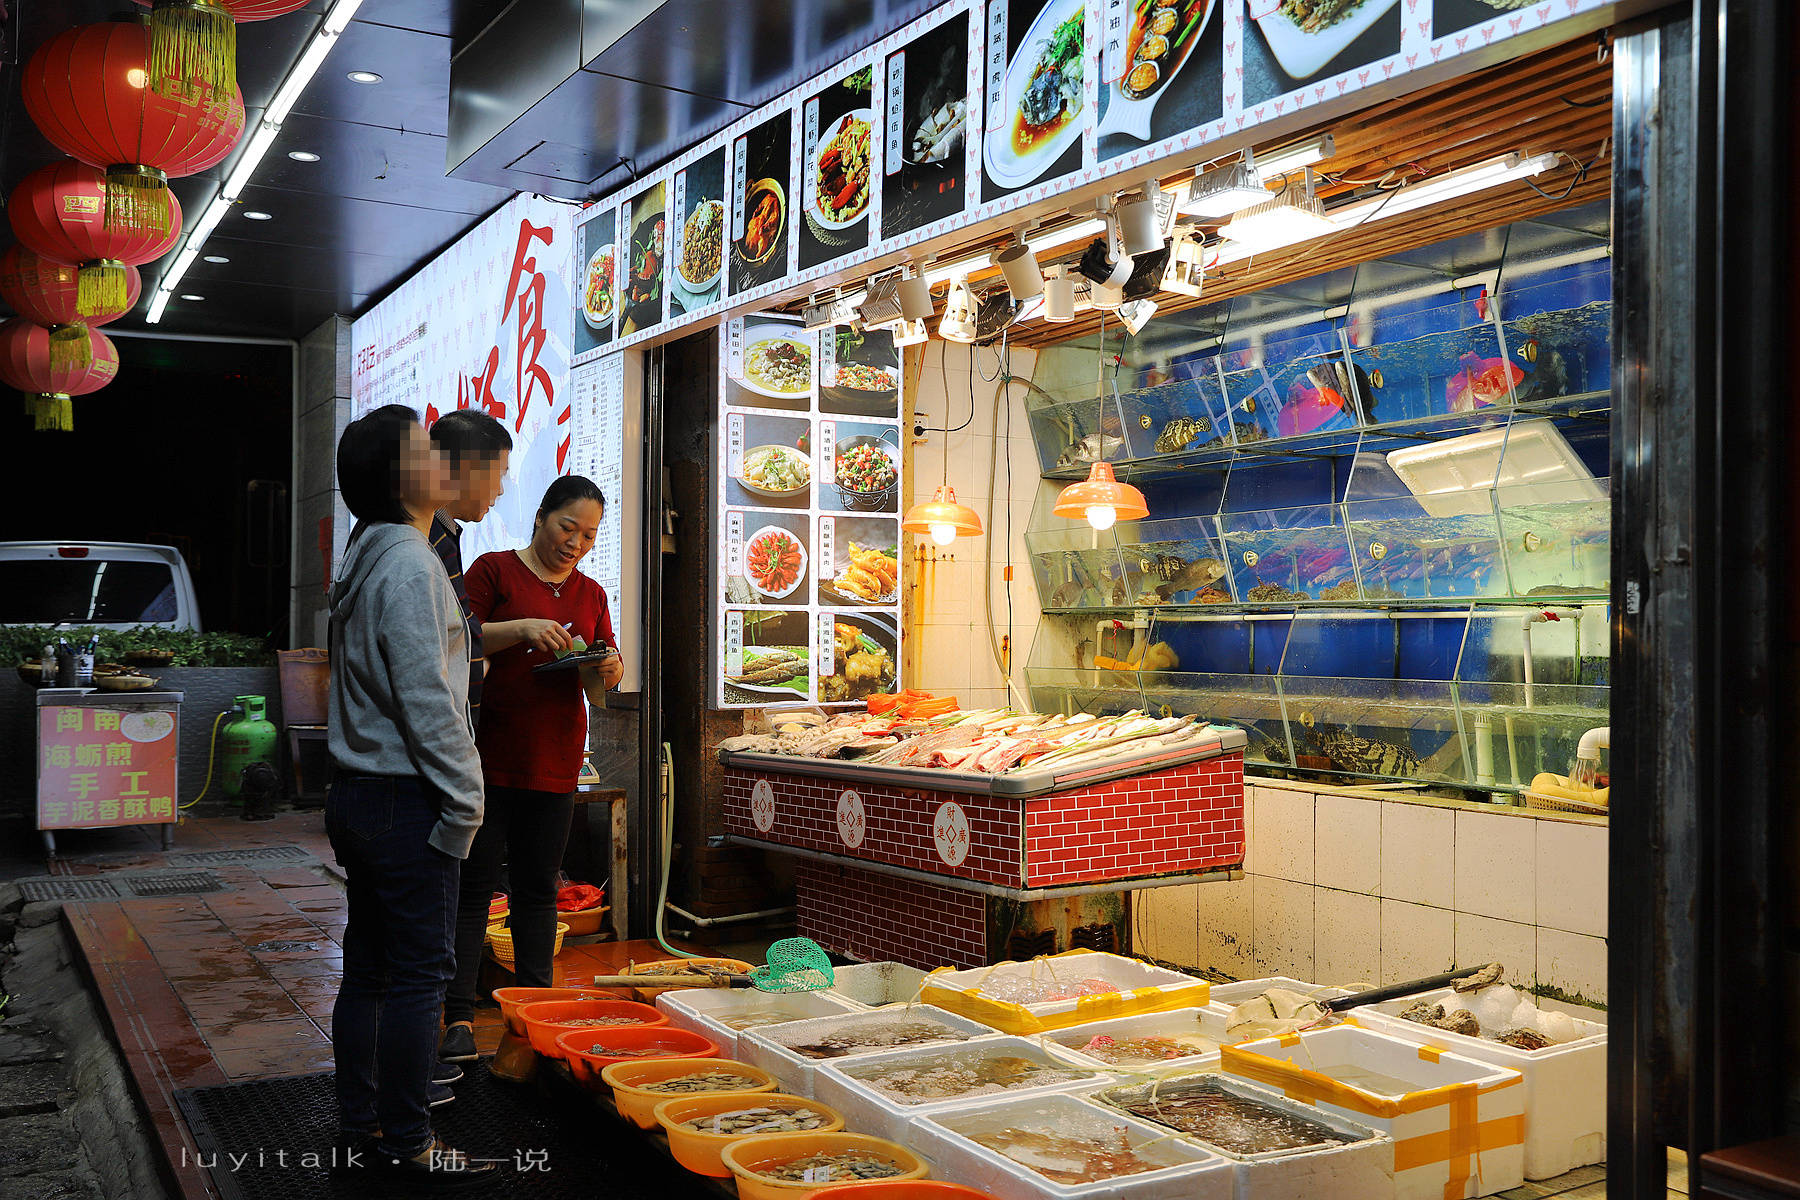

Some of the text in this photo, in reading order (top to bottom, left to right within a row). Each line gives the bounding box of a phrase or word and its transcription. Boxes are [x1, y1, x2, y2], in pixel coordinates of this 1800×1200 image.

[56, 708, 121, 733] 闽南
[44, 742, 133, 769] 海蛎煎
[68, 771, 150, 799] 手工
[45, 796, 173, 823] 芋泥香酥鸭
